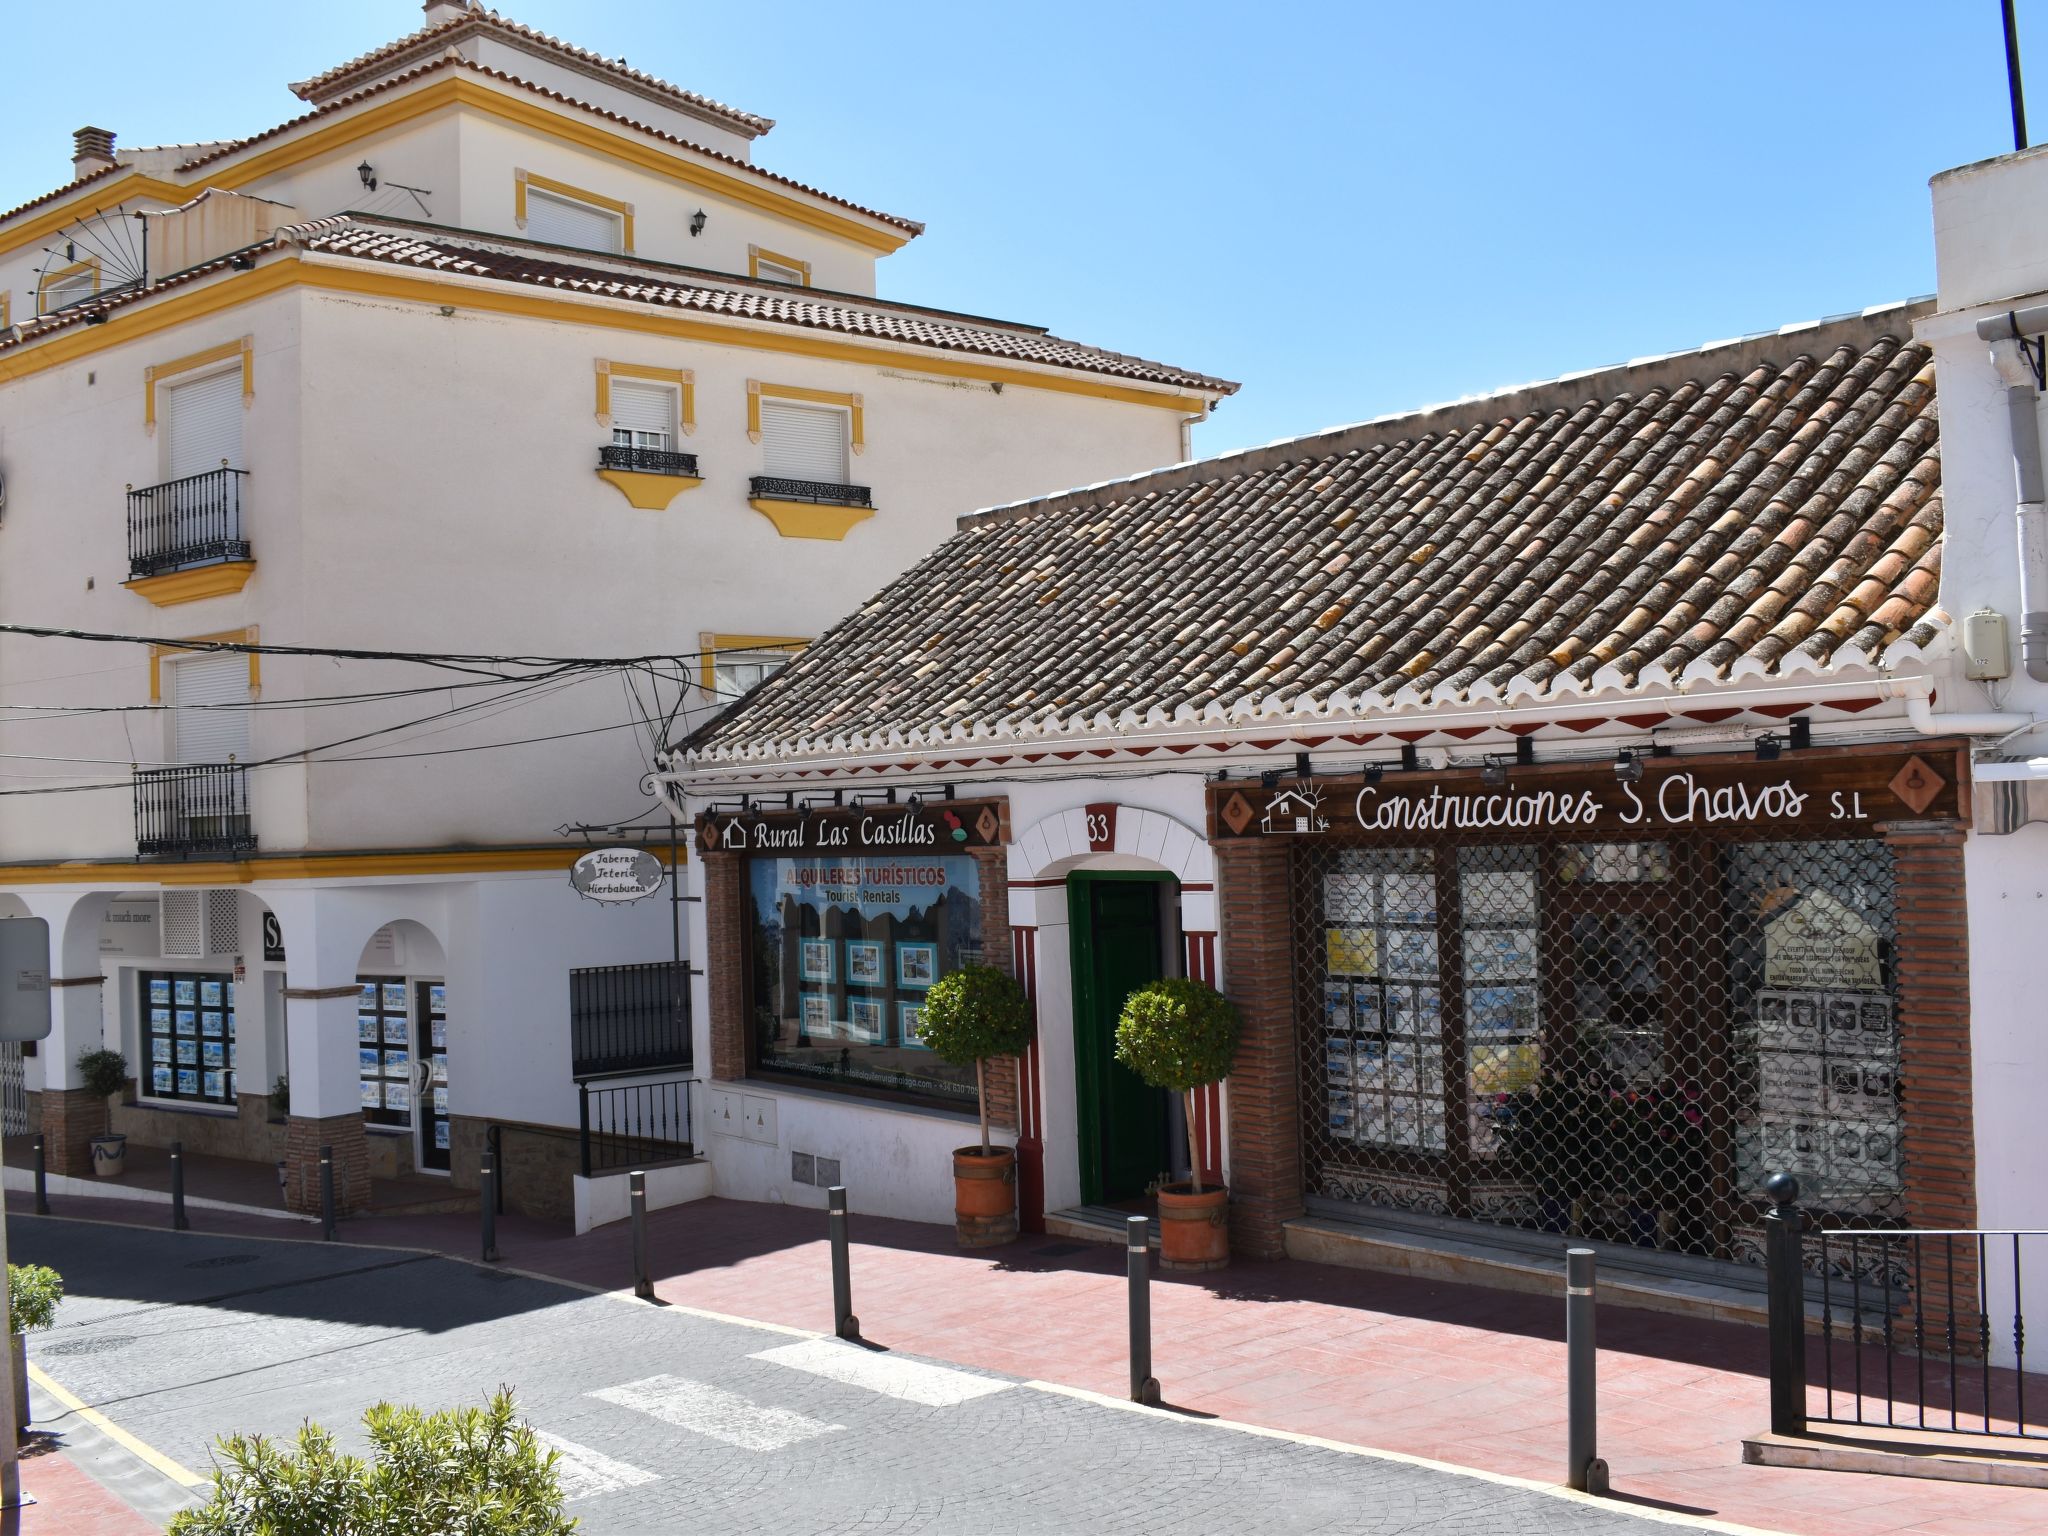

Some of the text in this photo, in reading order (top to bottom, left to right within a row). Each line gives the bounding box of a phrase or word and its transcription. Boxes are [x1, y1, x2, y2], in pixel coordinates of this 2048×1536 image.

[1355, 784, 1603, 830] Construcciones
[1618, 780, 1652, 824] S.
[1658, 772, 1809, 823] Chavos
[754, 814, 935, 848] Rural Las Casillas
[1087, 814, 1109, 842] 33
[787, 863, 946, 887] ALQUILERES TURÍSTICOS
[588, 884, 646, 893] Hierbabuena
[826, 890, 901, 904] Tourist Rentals
